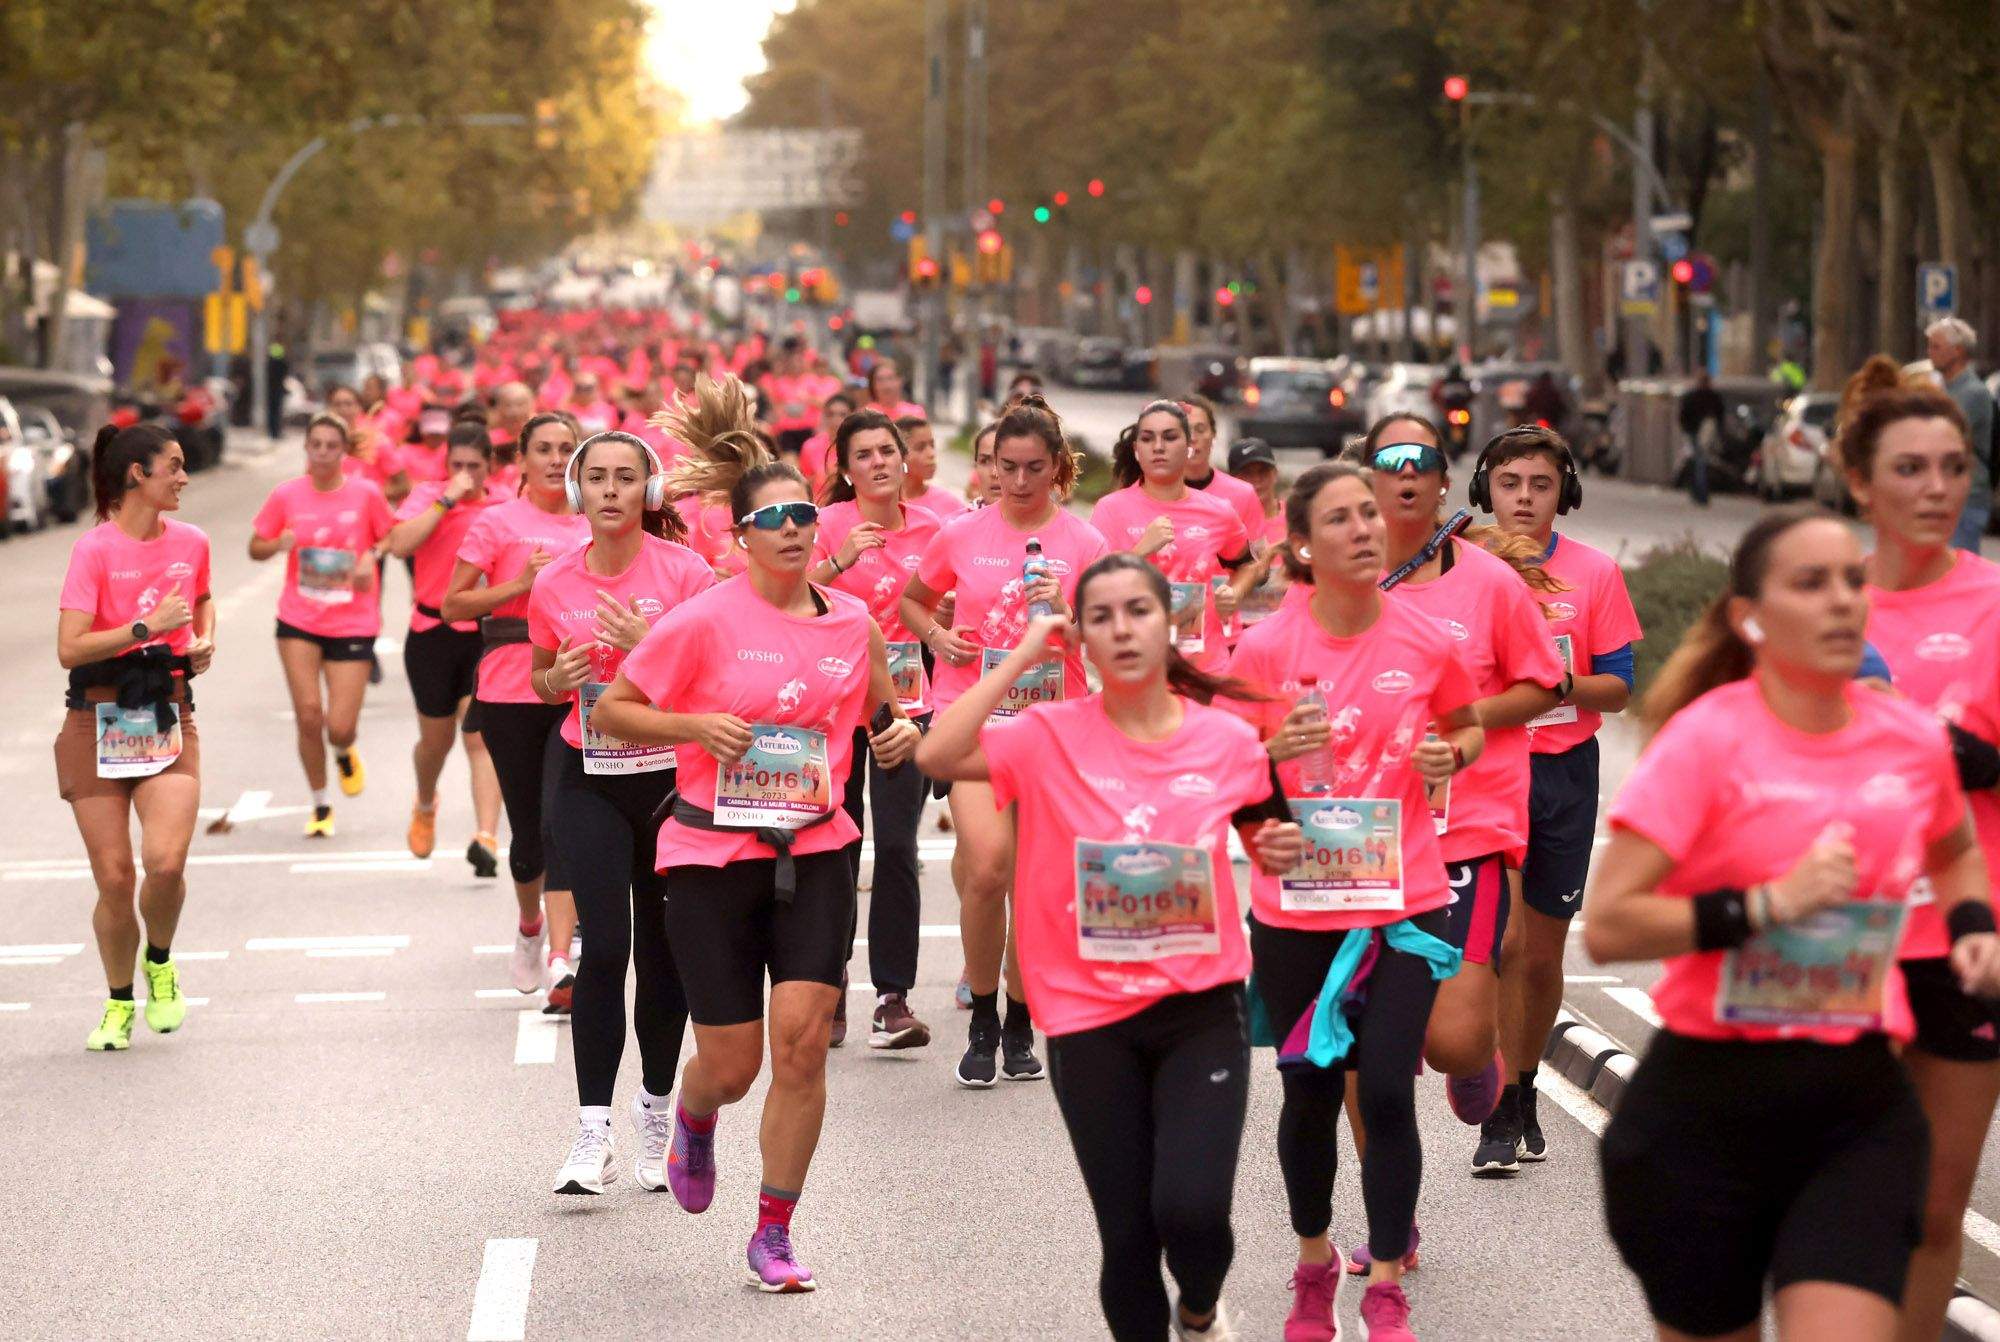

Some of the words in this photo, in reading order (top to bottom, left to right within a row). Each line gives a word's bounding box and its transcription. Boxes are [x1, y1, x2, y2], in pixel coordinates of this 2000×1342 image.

[1926, 270, 1949, 303] P
[972, 556, 1009, 567] OYSHO
[561, 609, 597, 621] OYSHO
[737, 648, 784, 663] OYSHO
[1008, 687, 1040, 700] 016
[757, 739, 799, 751] ASTURIANA
[593, 761, 624, 769] OYSHO
[755, 770, 798, 788] 016
[761, 791, 787, 799] 20733
[727, 798, 752, 806] CARRERA
[727, 811, 764, 820] OYSHO
[1121, 890, 1172, 914] 016
